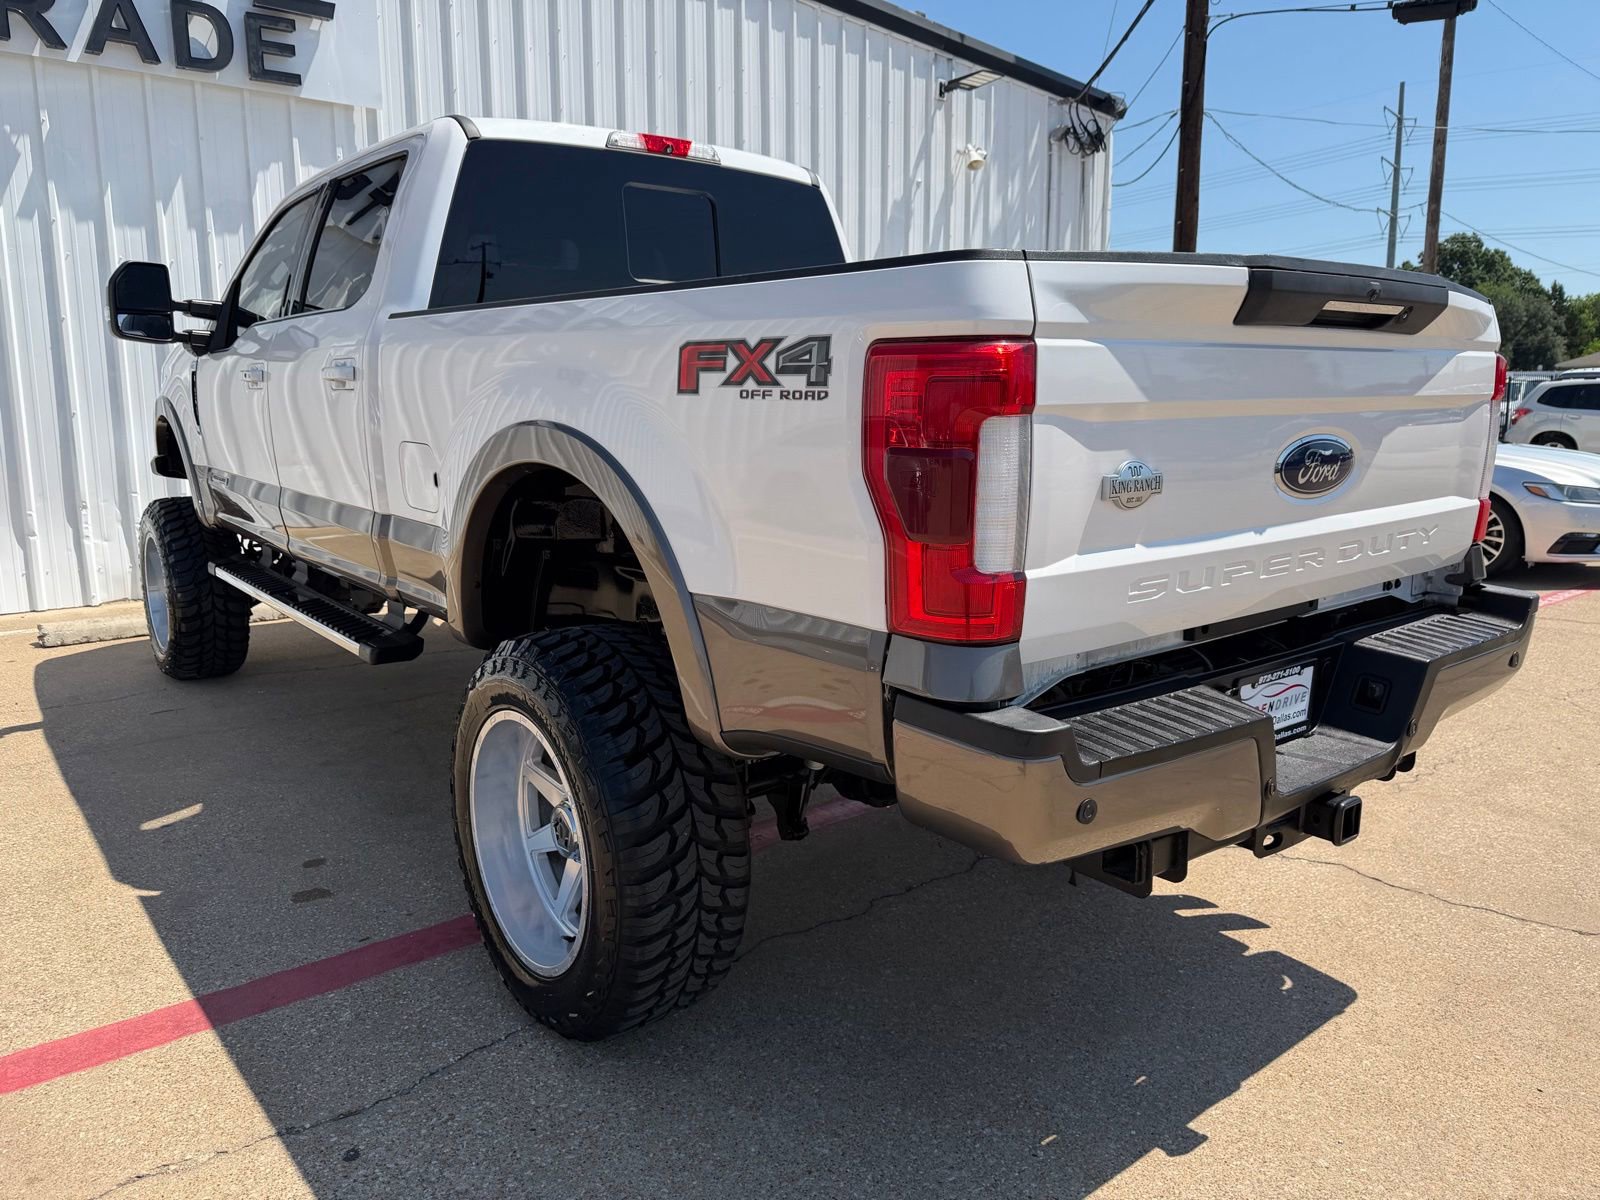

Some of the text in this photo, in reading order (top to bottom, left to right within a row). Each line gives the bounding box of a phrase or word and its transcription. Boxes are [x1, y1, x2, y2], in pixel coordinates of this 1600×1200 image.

[677, 334, 833, 395] FX4
[739, 389, 829, 401] OFF ROAD
[1112, 475, 1161, 495] KING RANCH
[1298, 449, 1341, 485] Ford
[1127, 524, 1439, 604] SUPER DUTY
